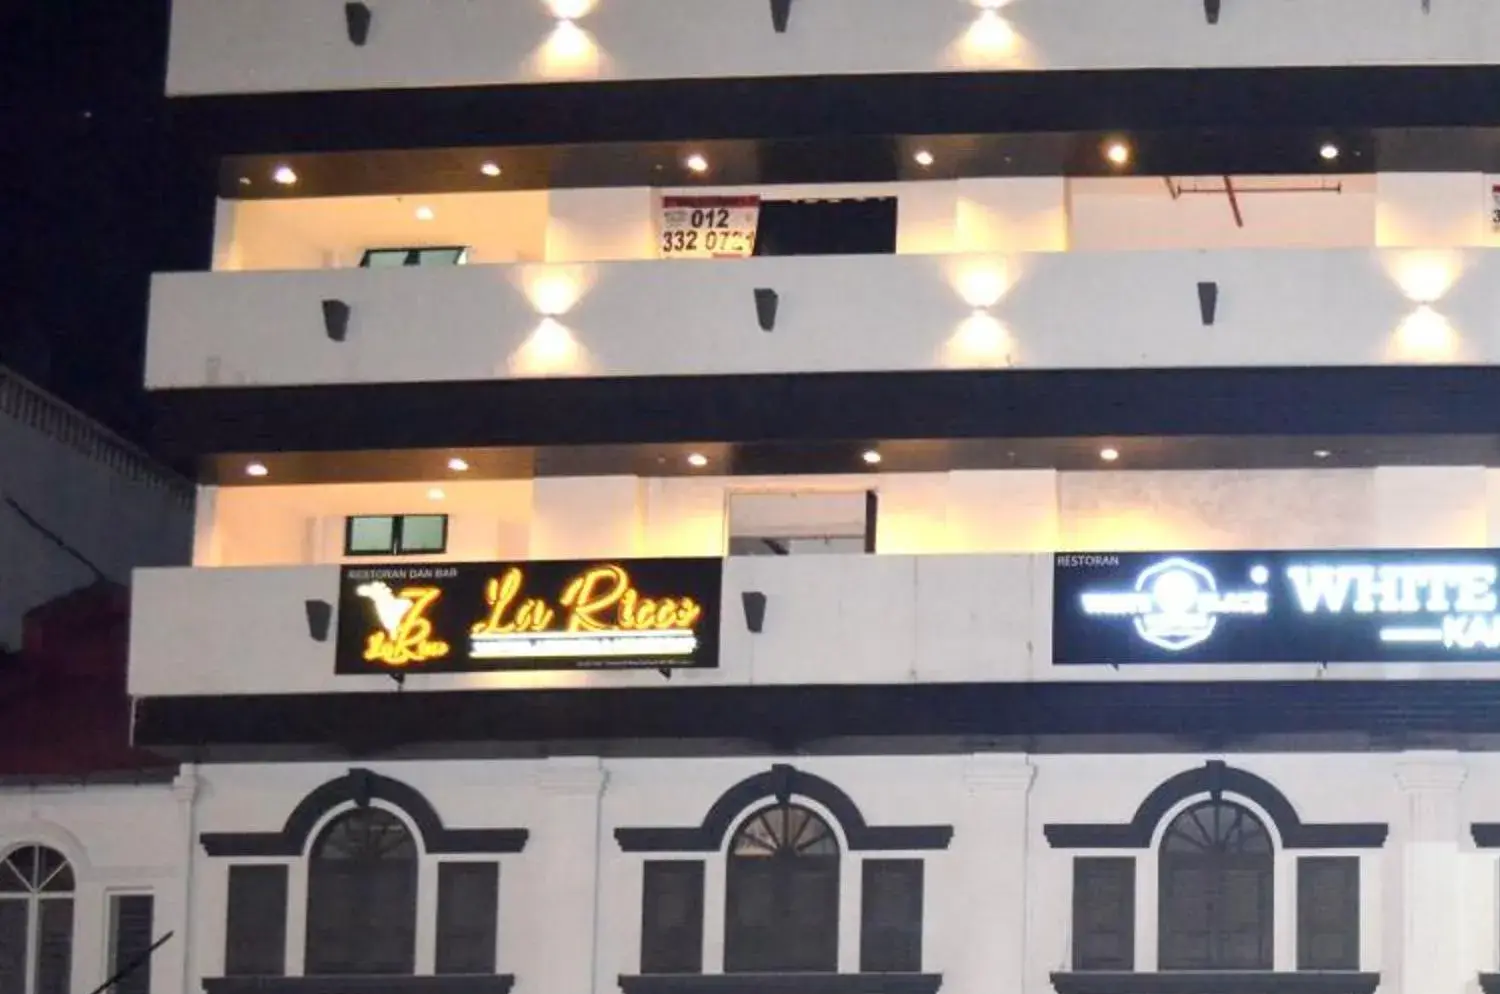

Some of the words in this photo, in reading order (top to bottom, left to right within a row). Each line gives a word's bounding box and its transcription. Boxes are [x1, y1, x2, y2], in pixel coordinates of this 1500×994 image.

[691, 209, 729, 228] 012
[663, 230, 697, 252] 332
[1057, 554, 1119, 567] RESTORAN
[1286, 563, 1498, 613] WHITE
